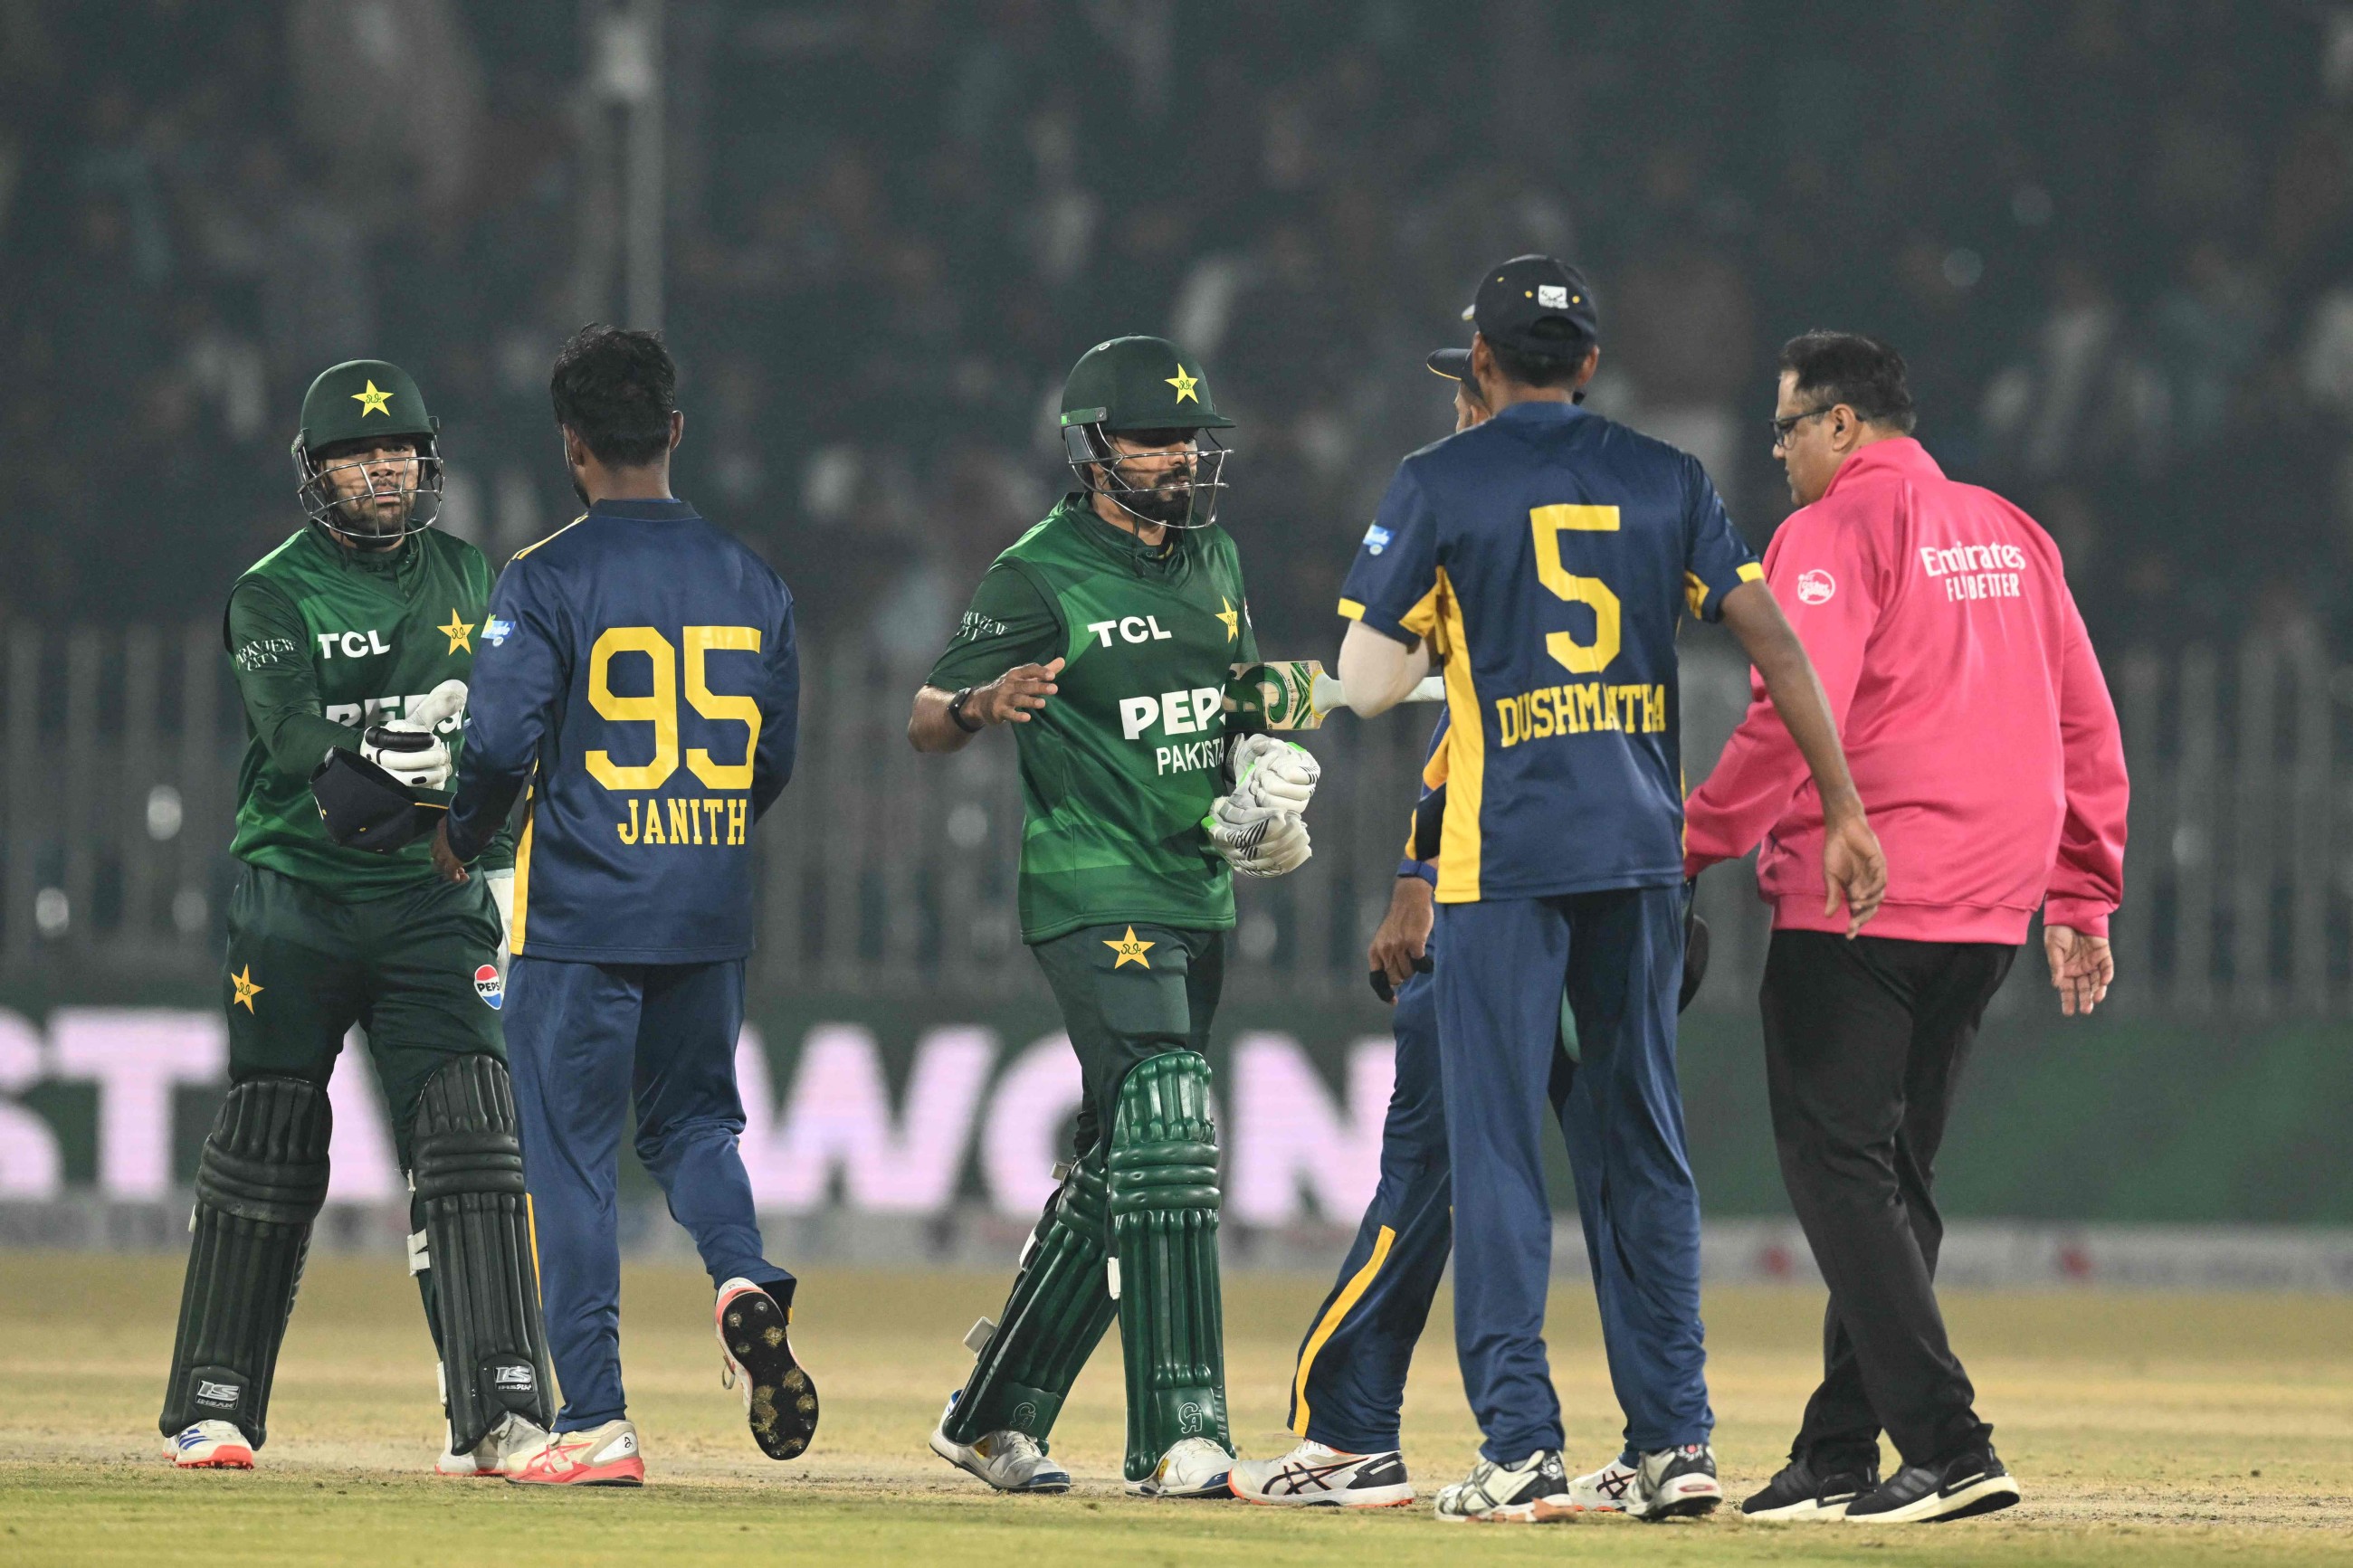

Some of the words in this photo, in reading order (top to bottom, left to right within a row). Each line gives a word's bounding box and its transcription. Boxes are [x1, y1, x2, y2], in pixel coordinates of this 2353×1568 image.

[1920, 541, 2026, 577] Emirates
[1529, 504, 1621, 674] 5
[318, 630, 390, 659] TCL
[1088, 614, 1172, 647] TCL
[586, 626, 763, 790] 95
[1119, 683, 1225, 740] PEP
[617, 798, 748, 845] JANITH
